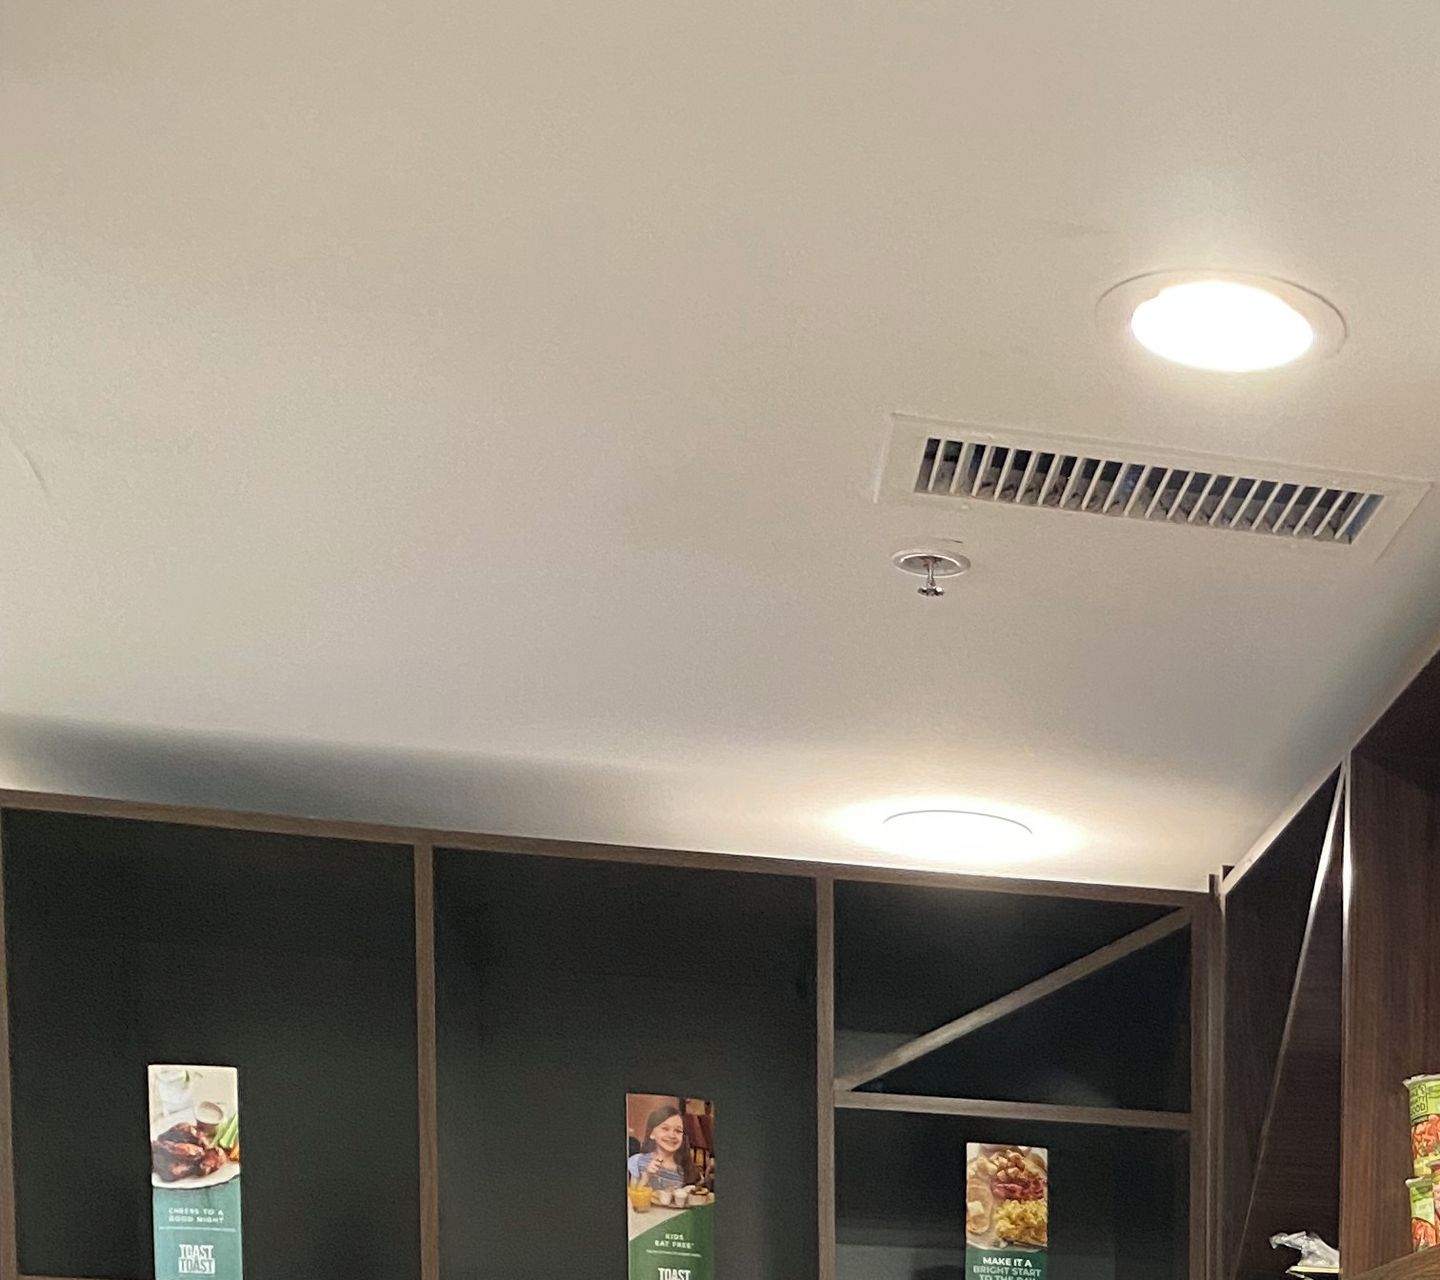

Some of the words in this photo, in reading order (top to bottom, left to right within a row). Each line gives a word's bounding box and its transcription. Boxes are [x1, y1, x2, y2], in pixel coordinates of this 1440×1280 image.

[179, 1244, 214, 1259] TOAST
[180, 1259, 213, 1273] TOAST
[982, 1257, 1011, 1266] MAKE
[1013, 1258, 1023, 1267] IT
[1024, 1259, 1032, 1267] A
[973, 1265, 1009, 1275] BRIGHT
[1012, 1267, 1041, 1277] START
